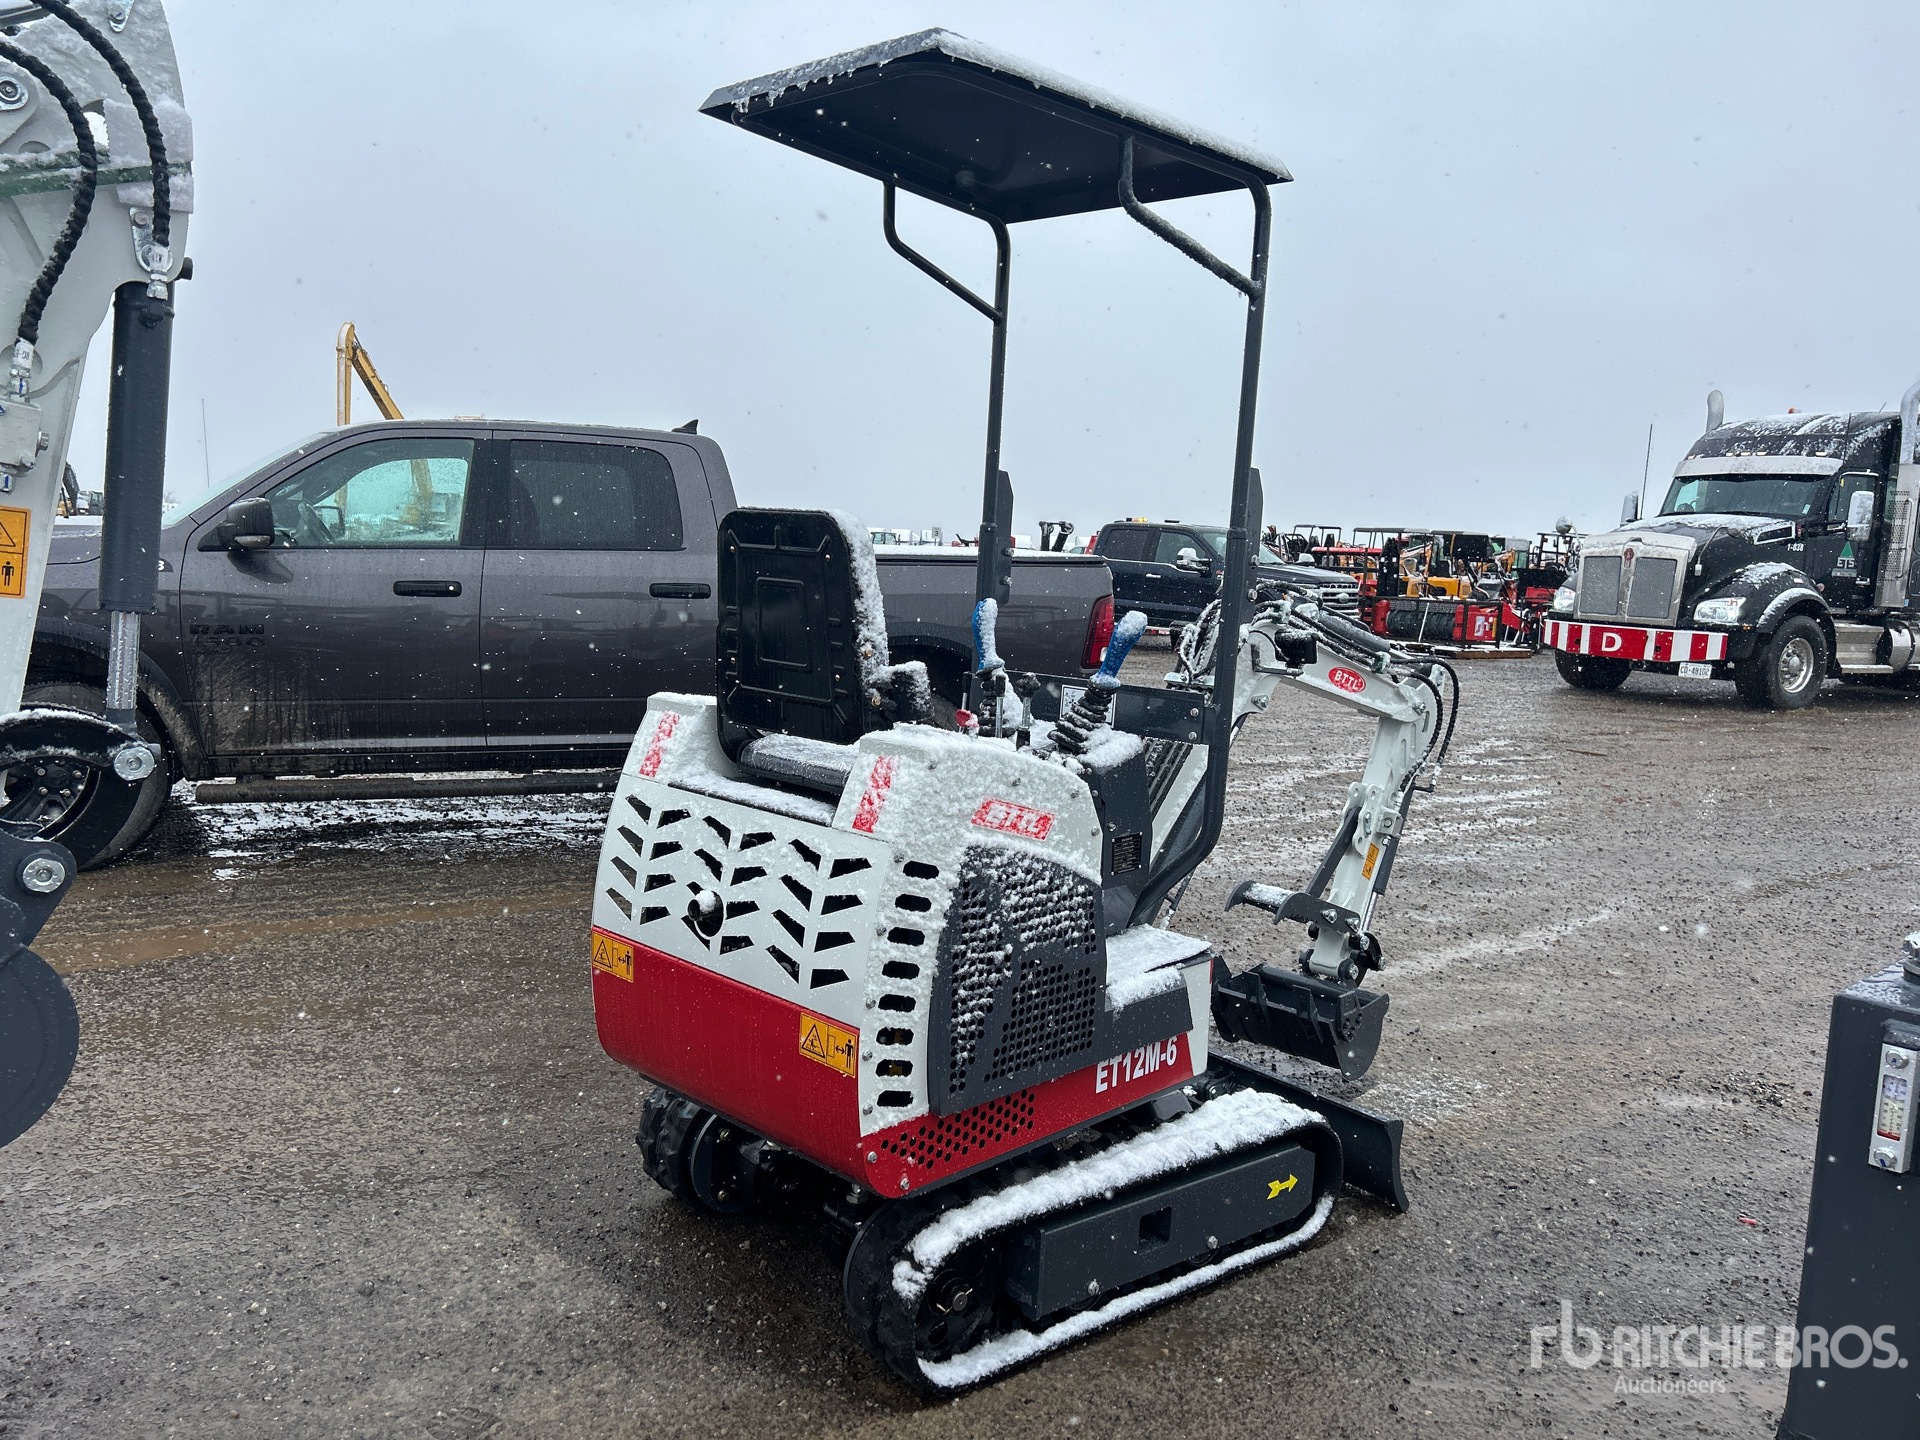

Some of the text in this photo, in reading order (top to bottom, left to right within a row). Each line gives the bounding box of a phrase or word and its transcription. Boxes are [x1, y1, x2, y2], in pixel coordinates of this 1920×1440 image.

[189, 624, 265, 635] RAM
[1601, 631, 1623, 652] D
[1333, 669, 1359, 691] BTTL
[1095, 1035, 1178, 1094] ET12M-6
